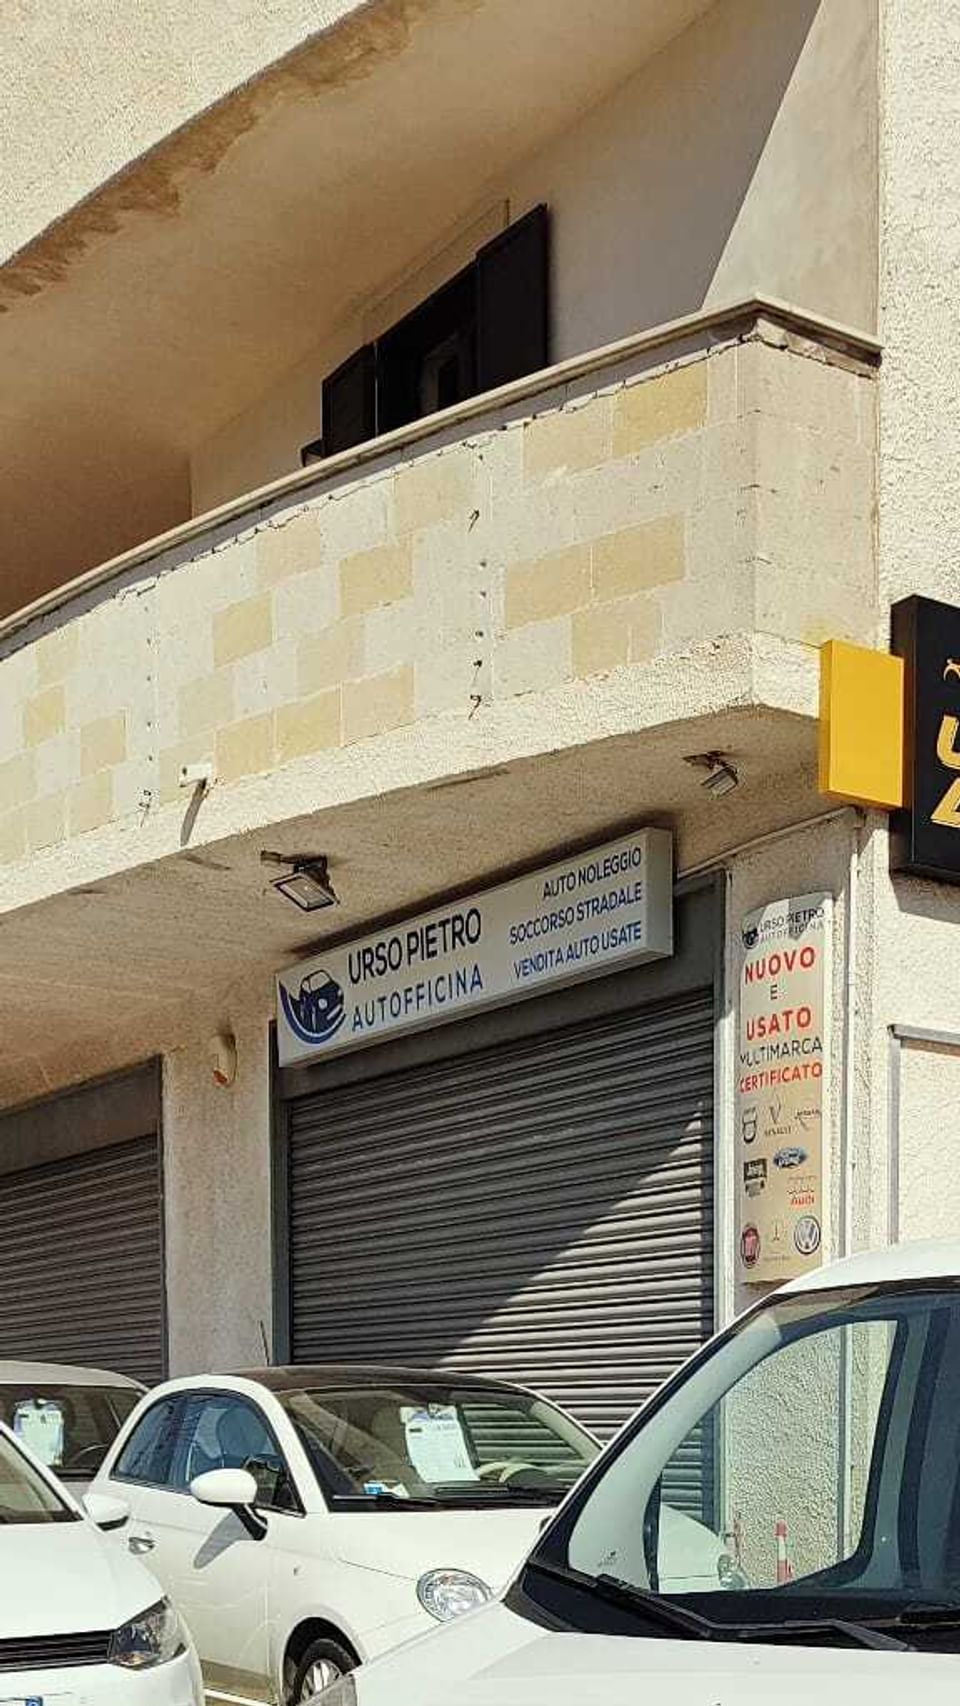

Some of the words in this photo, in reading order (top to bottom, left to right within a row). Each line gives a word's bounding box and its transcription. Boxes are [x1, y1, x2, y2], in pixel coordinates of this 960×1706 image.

[543, 872, 576, 900] AUTO
[579, 847, 641, 886] NOLEGGIO
[510, 906, 574, 945] SOCCORSO
[576, 881, 642, 921] STRADALE
[349, 937, 402, 984] URSO
[407, 908, 481, 966] PIETRO
[514, 946, 563, 979] VENDITA
[566, 935, 600, 961] AUTO
[601, 921, 642, 951] USATE
[745, 947, 815, 985] NUOVO
[352, 963, 483, 1032] AUTOFFICINA
[770, 984, 778, 1001] E
[746, 1006, 811, 1041] USATO
[740, 1062, 823, 1093] CERTIFICATO
